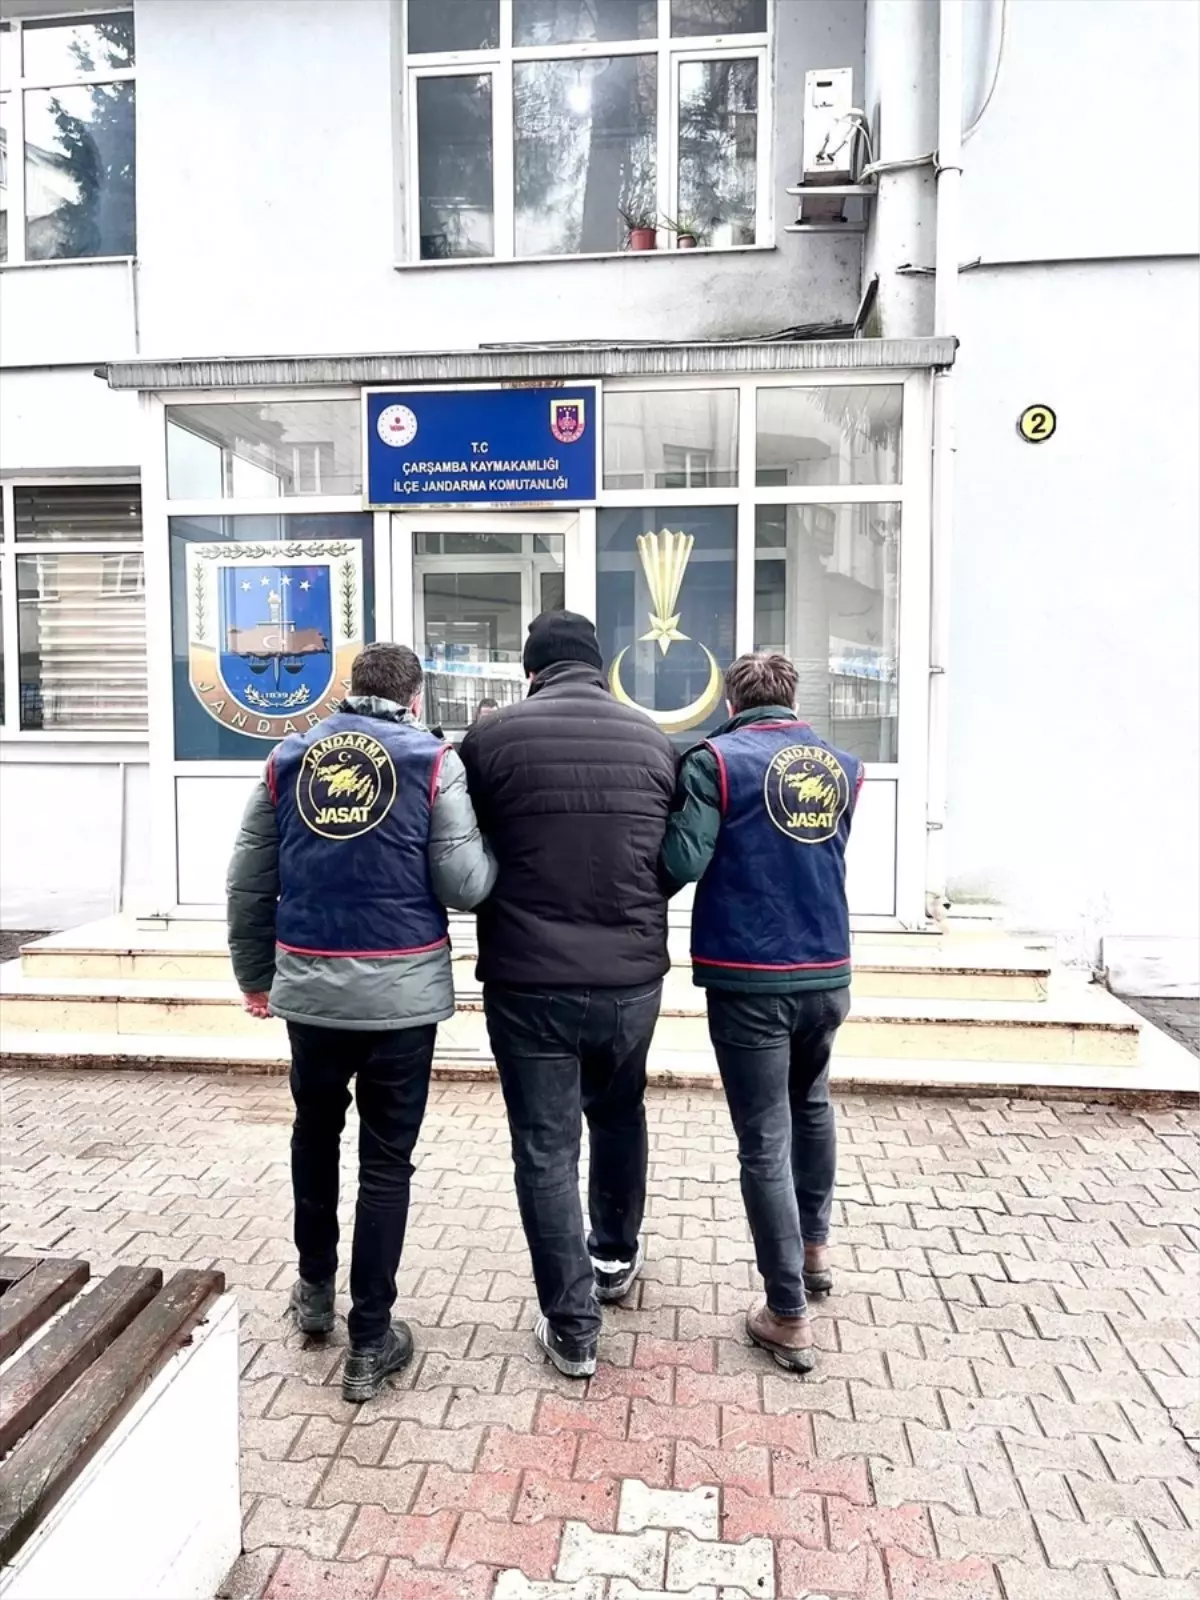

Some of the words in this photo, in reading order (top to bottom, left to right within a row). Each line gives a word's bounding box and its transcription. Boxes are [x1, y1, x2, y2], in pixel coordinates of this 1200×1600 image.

[1031, 412, 1046, 434] 2
[471, 441, 489, 454] T.C
[402, 462, 469, 476] ÇARŞAMBA
[470, 457, 559, 473] KAYMAKAMLIĞI
[393, 479, 420, 495] İLÇE
[422, 479, 487, 493] JANDARMA
[489, 476, 569, 491] KOMUTANLIĞI
[306, 734, 388, 769] JANDARMA
[772, 747, 842, 780] JANDARMA
[315, 806, 371, 825] JASAT
[787, 812, 834, 828] JASAT
